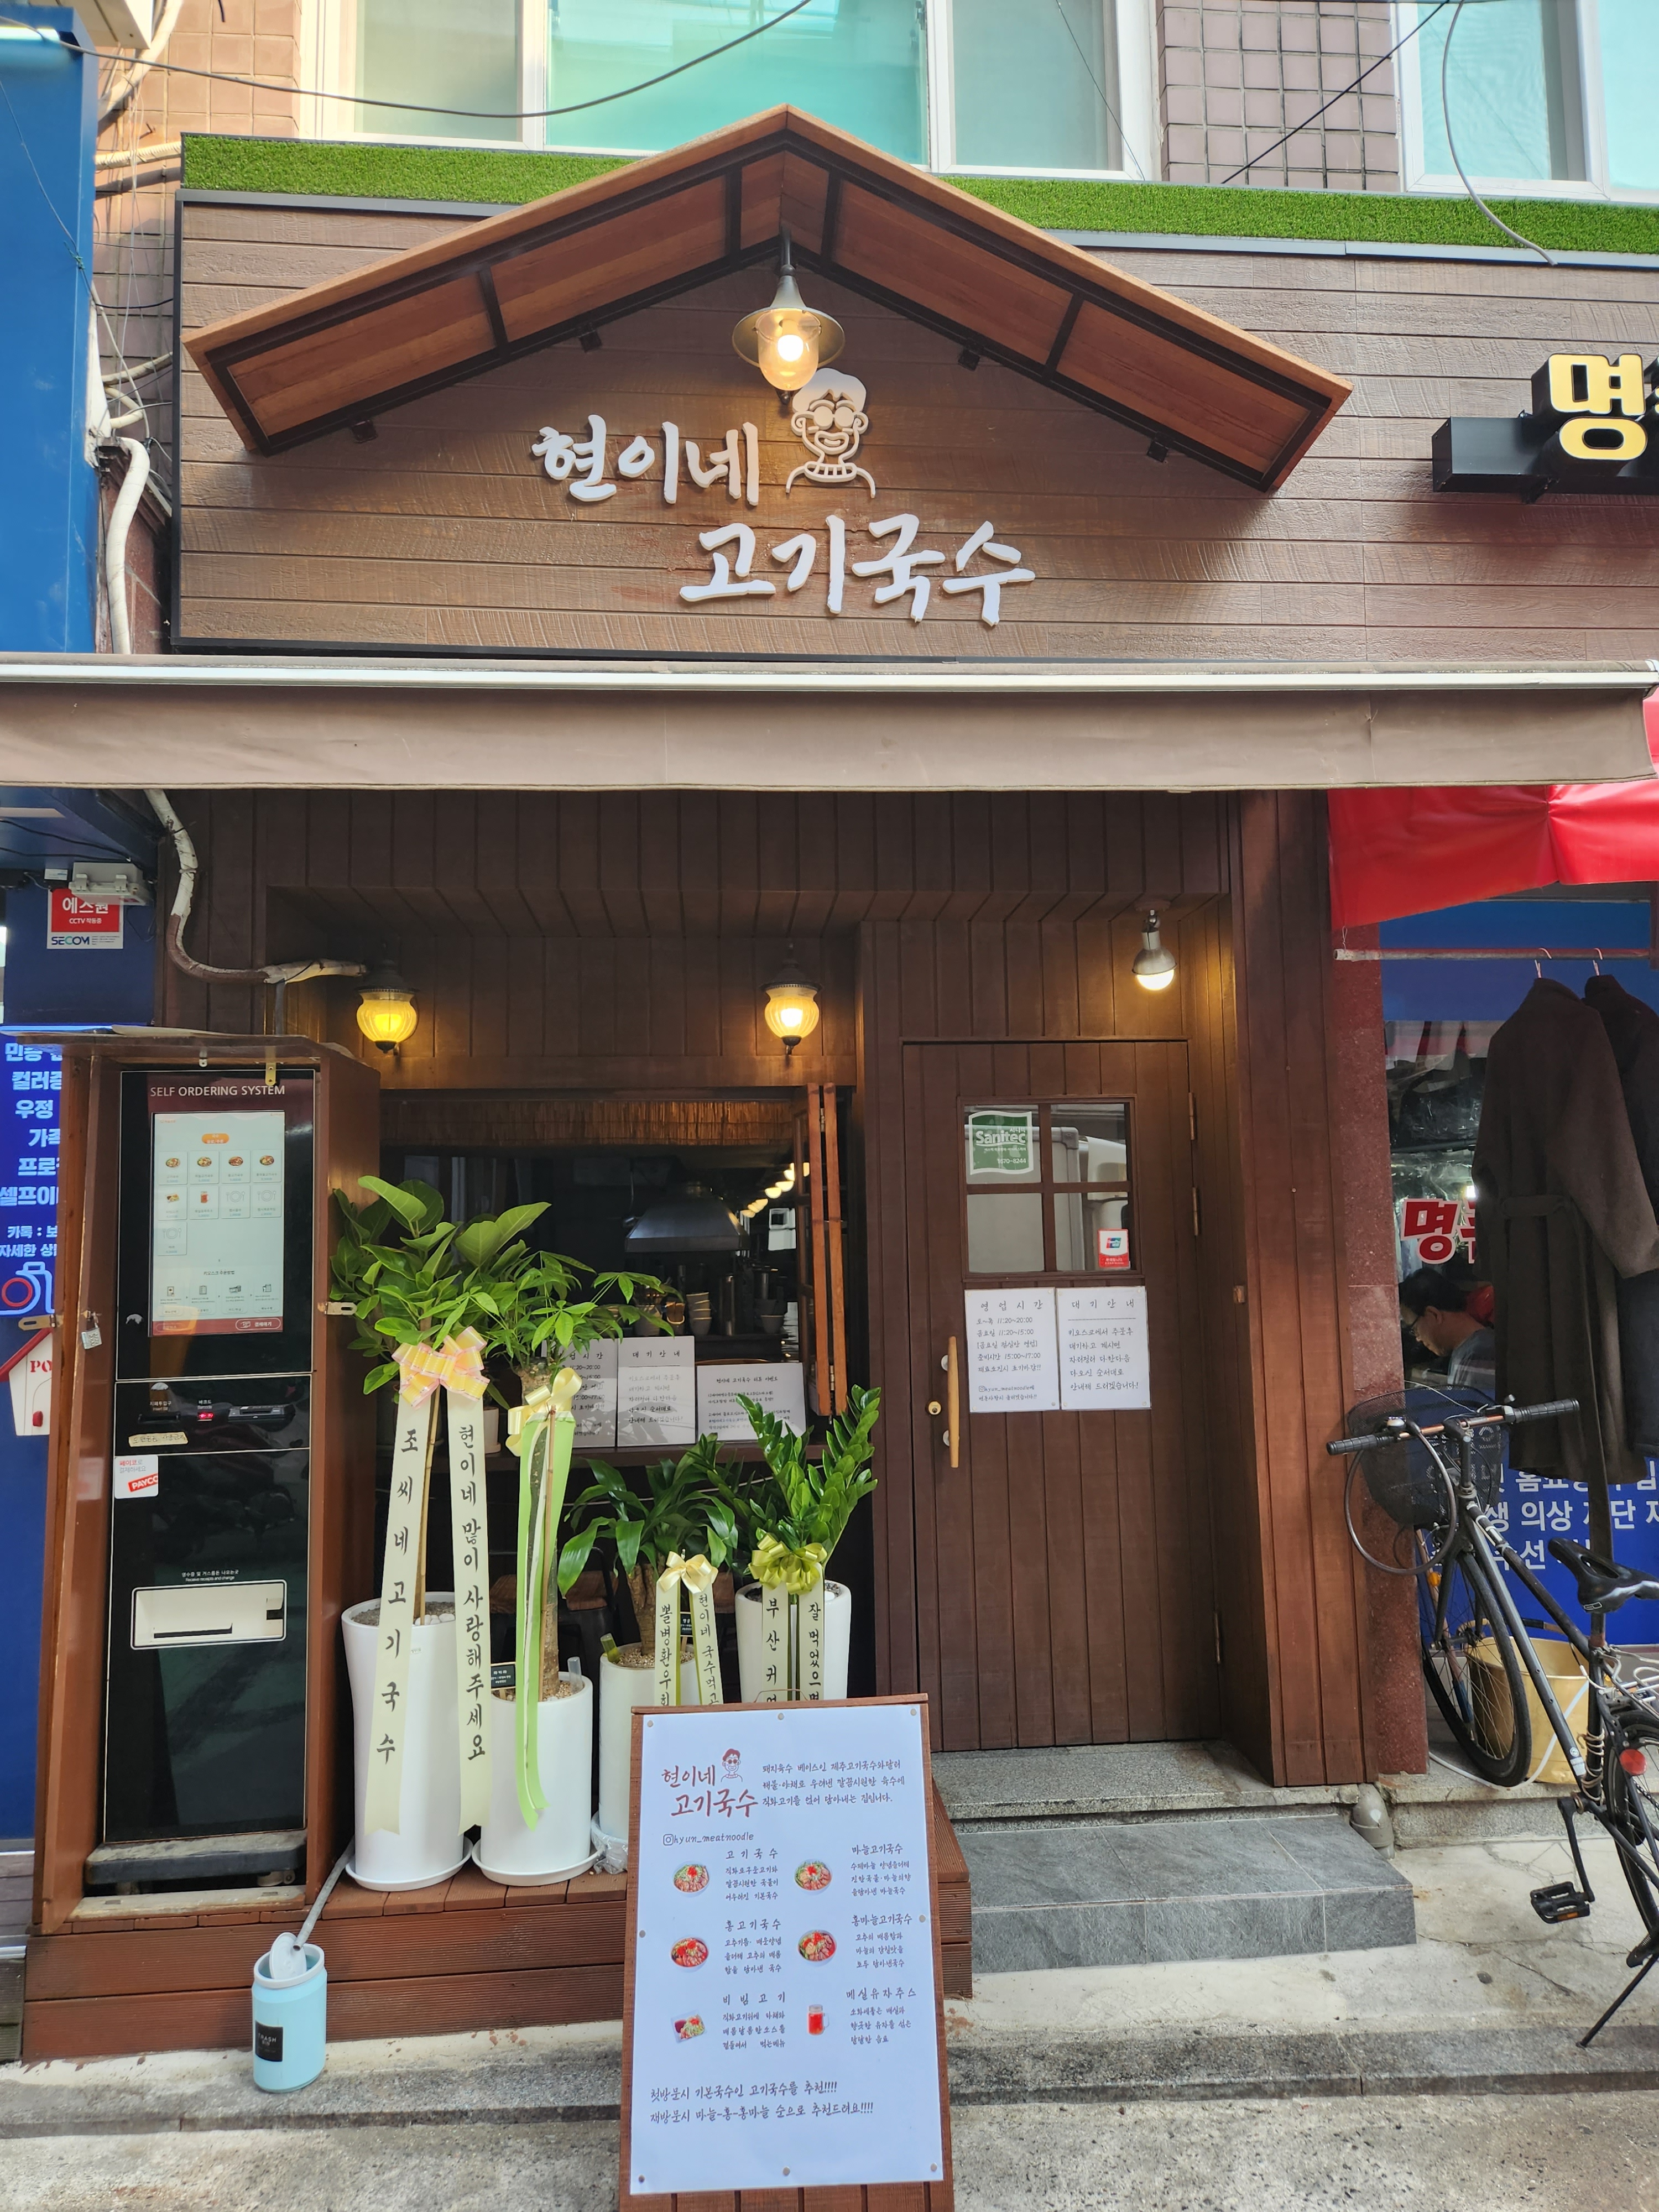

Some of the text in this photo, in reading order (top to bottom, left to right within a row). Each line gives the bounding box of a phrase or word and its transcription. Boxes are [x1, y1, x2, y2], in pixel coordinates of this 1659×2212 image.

[1548, 354, 1659, 460] 명
[531, 414, 759, 506] 현이네
[679, 513, 1036, 627] 고기국수
[51, 936, 90, 945] SECOM
[150, 1086, 285, 1097] SELF ORDERING SYSTEM
[15, 1099, 53, 1119] 우정
[975, 1130, 1026, 1144] Sanitec
[18, 1157, 60, 1176] 프로
[0, 1186, 59, 1206] 셀프이
[0, 1244, 36, 1258] 자세한
[980, 1300, 1043, 1312] 영업시간
[1072, 1298, 1134, 1309] 대기안내
[1112, 1327, 1133, 1335] 주문후
[1097, 1368, 1124, 1376] 순서대로
[132, 1475, 158, 1490] PAYCO
[762, 1763, 793, 1774] 돼지육수
[797, 1761, 827, 1772] 베이스인
[661, 1765, 716, 1788] 현이네
[810, 1778, 833, 1789] 우려낸
[837, 1776, 877, 1788] 깔끔시원한
[881, 1776, 905, 1786] 육수에
[671, 1788, 759, 1818] 고기국수
[762, 1795, 801, 1807] 직화고기를
[825, 1793, 857, 1804] 담아내는
[861, 1792, 893, 1803] 집입니다.
[674, 1832, 754, 1843] hyun_meatnoodle
[726, 1848, 778, 1860] 고기국수
[852, 1843, 903, 1855] 마늘고기국수
[754, 1891, 778, 1900] 기본국수
[880, 1886, 906, 1895] 마늘국수
[725, 1918, 781, 1932] 홍고기국수
[852, 1913, 912, 1927] 홍마늘고기국수
[855, 1933, 874, 1942] 고추의
[855, 1946, 874, 1955] 마늘의
[769, 1964, 782, 1973] 국수
[723, 1991, 785, 2006] 비빔고기
[258, 2033, 276, 2042] TRASH
[650, 2080, 837, 2103] 첫방문시 기본국수인 고기국수를 추천!!!!
[650, 2108, 690, 2124] 재방문시
[775, 2104, 806, 2118] 순으로
